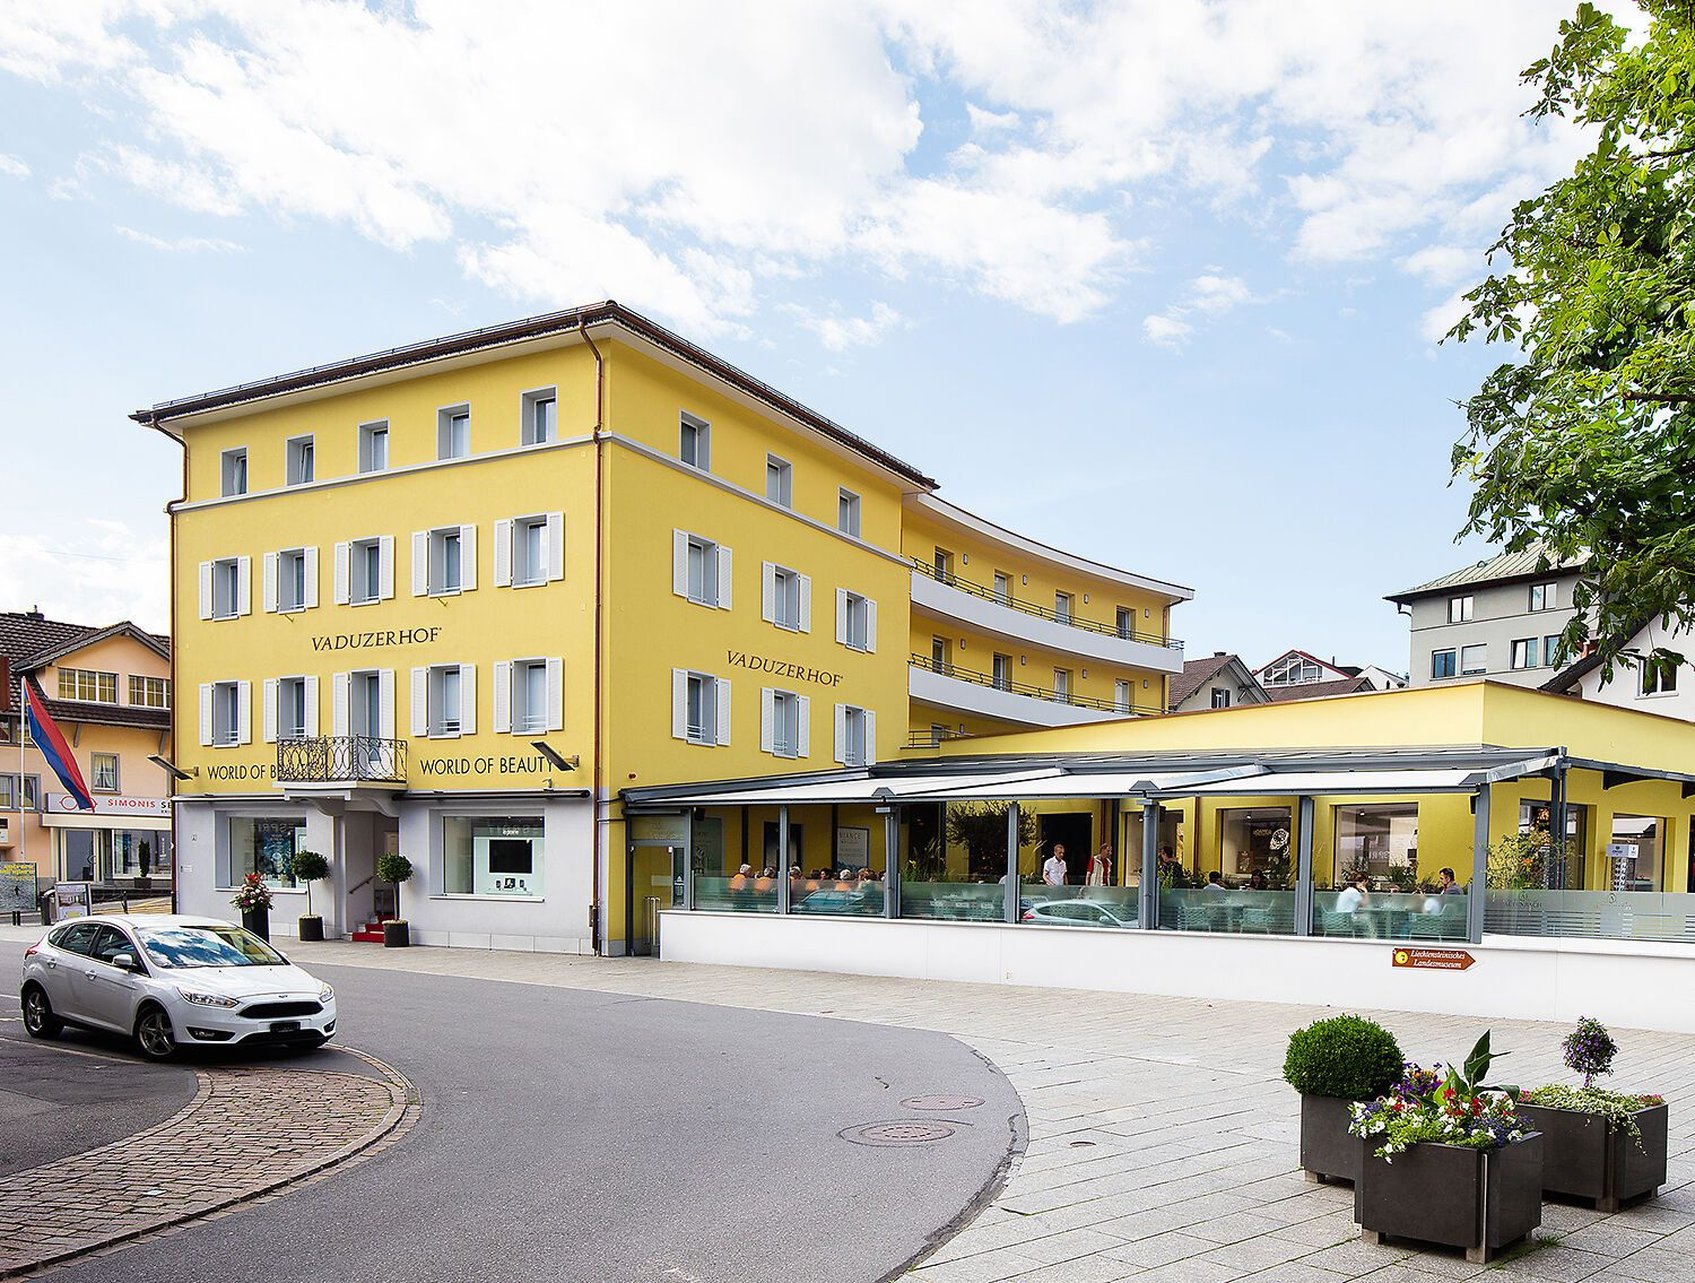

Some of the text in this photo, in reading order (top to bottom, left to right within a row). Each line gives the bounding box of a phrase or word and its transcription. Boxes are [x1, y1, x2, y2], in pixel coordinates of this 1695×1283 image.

[312, 627, 441, 651] VADUZERHOF
[727, 650, 843, 687] VADUZERHOF
[207, 765, 247, 780] WORLD
[250, 765, 266, 779] OF
[420, 759, 470, 775] WORLD
[474, 758, 494, 774] OF
[108, 798, 156, 809] SIMONIS
